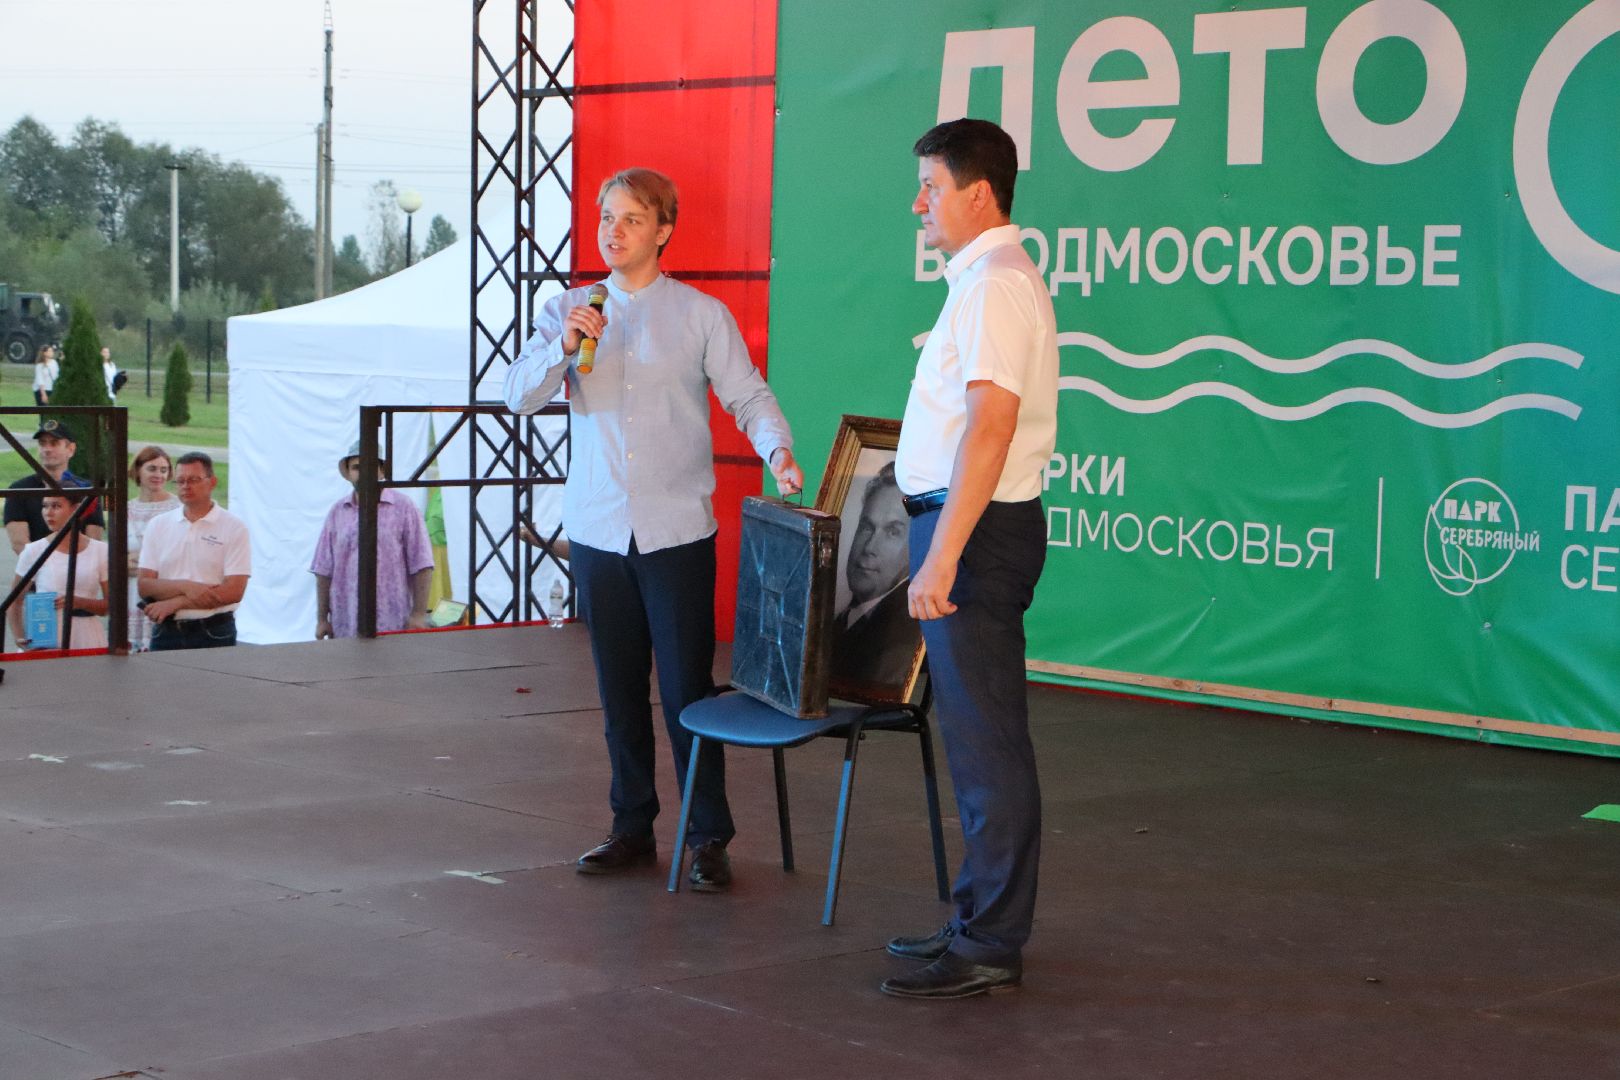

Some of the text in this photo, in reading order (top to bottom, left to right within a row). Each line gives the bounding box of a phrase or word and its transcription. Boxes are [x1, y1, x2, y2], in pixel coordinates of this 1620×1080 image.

[1020, 225, 1462, 297] ОДМОСКОВЬЕ
[1443, 498, 1502, 523] ПАРК
[1439, 526, 1541, 552] СЕРЕБРЯНЫЙ
